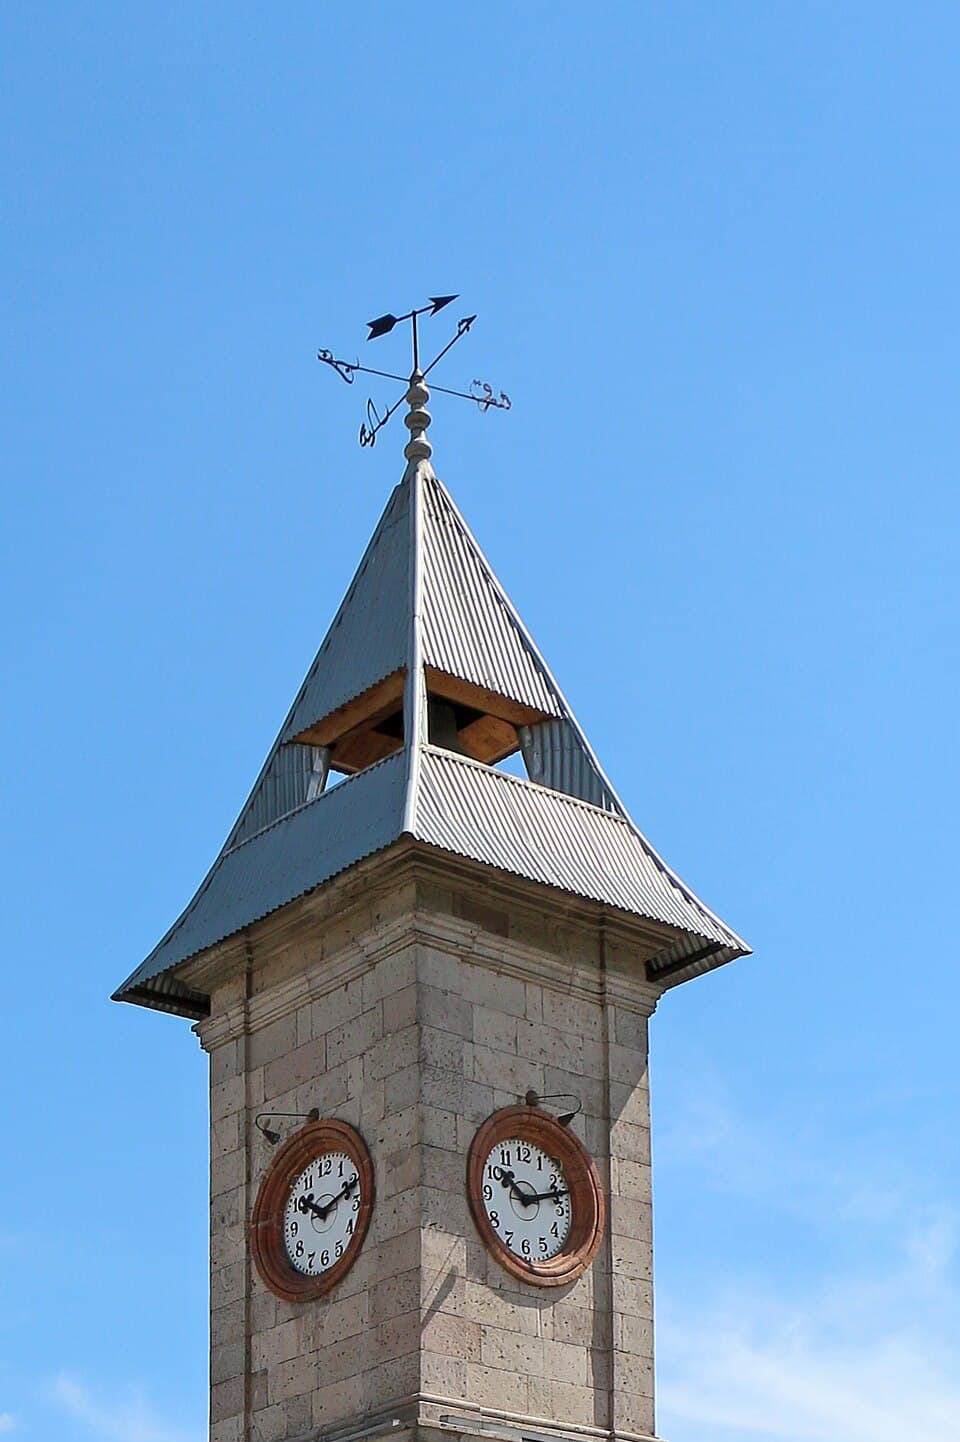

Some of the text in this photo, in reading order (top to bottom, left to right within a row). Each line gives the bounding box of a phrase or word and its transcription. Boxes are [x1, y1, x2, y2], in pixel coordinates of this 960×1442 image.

[501, 1149, 512, 1167] 11
[516, 1146, 531, 1164] 12
[536, 1155, 542, 1171] 1
[318, 1159, 332, 1178] 12
[338, 1161, 344, 1177] 1
[488, 1165, 503, 1181] 10
[304, 1175, 313, 1191] 11
[549, 1174, 558, 1191] 2
[483, 1184, 493, 1201] 9
[352, 1194, 360, 1211] 3
[346, 1218, 353, 1235] 4
[489, 1210, 500, 1228] 8
[290, 1221, 298, 1237] 9
[550, 1221, 559, 1238] 4
[505, 1231, 514, 1247] 7
[521, 1239, 530, 1255] 6
[539, 1237, 548, 1252] 5
[295, 1240, 304, 1257] 8
[335, 1240, 344, 1257] 5
[307, 1252, 315, 1269] 7
[321, 1250, 329, 1266] 6
